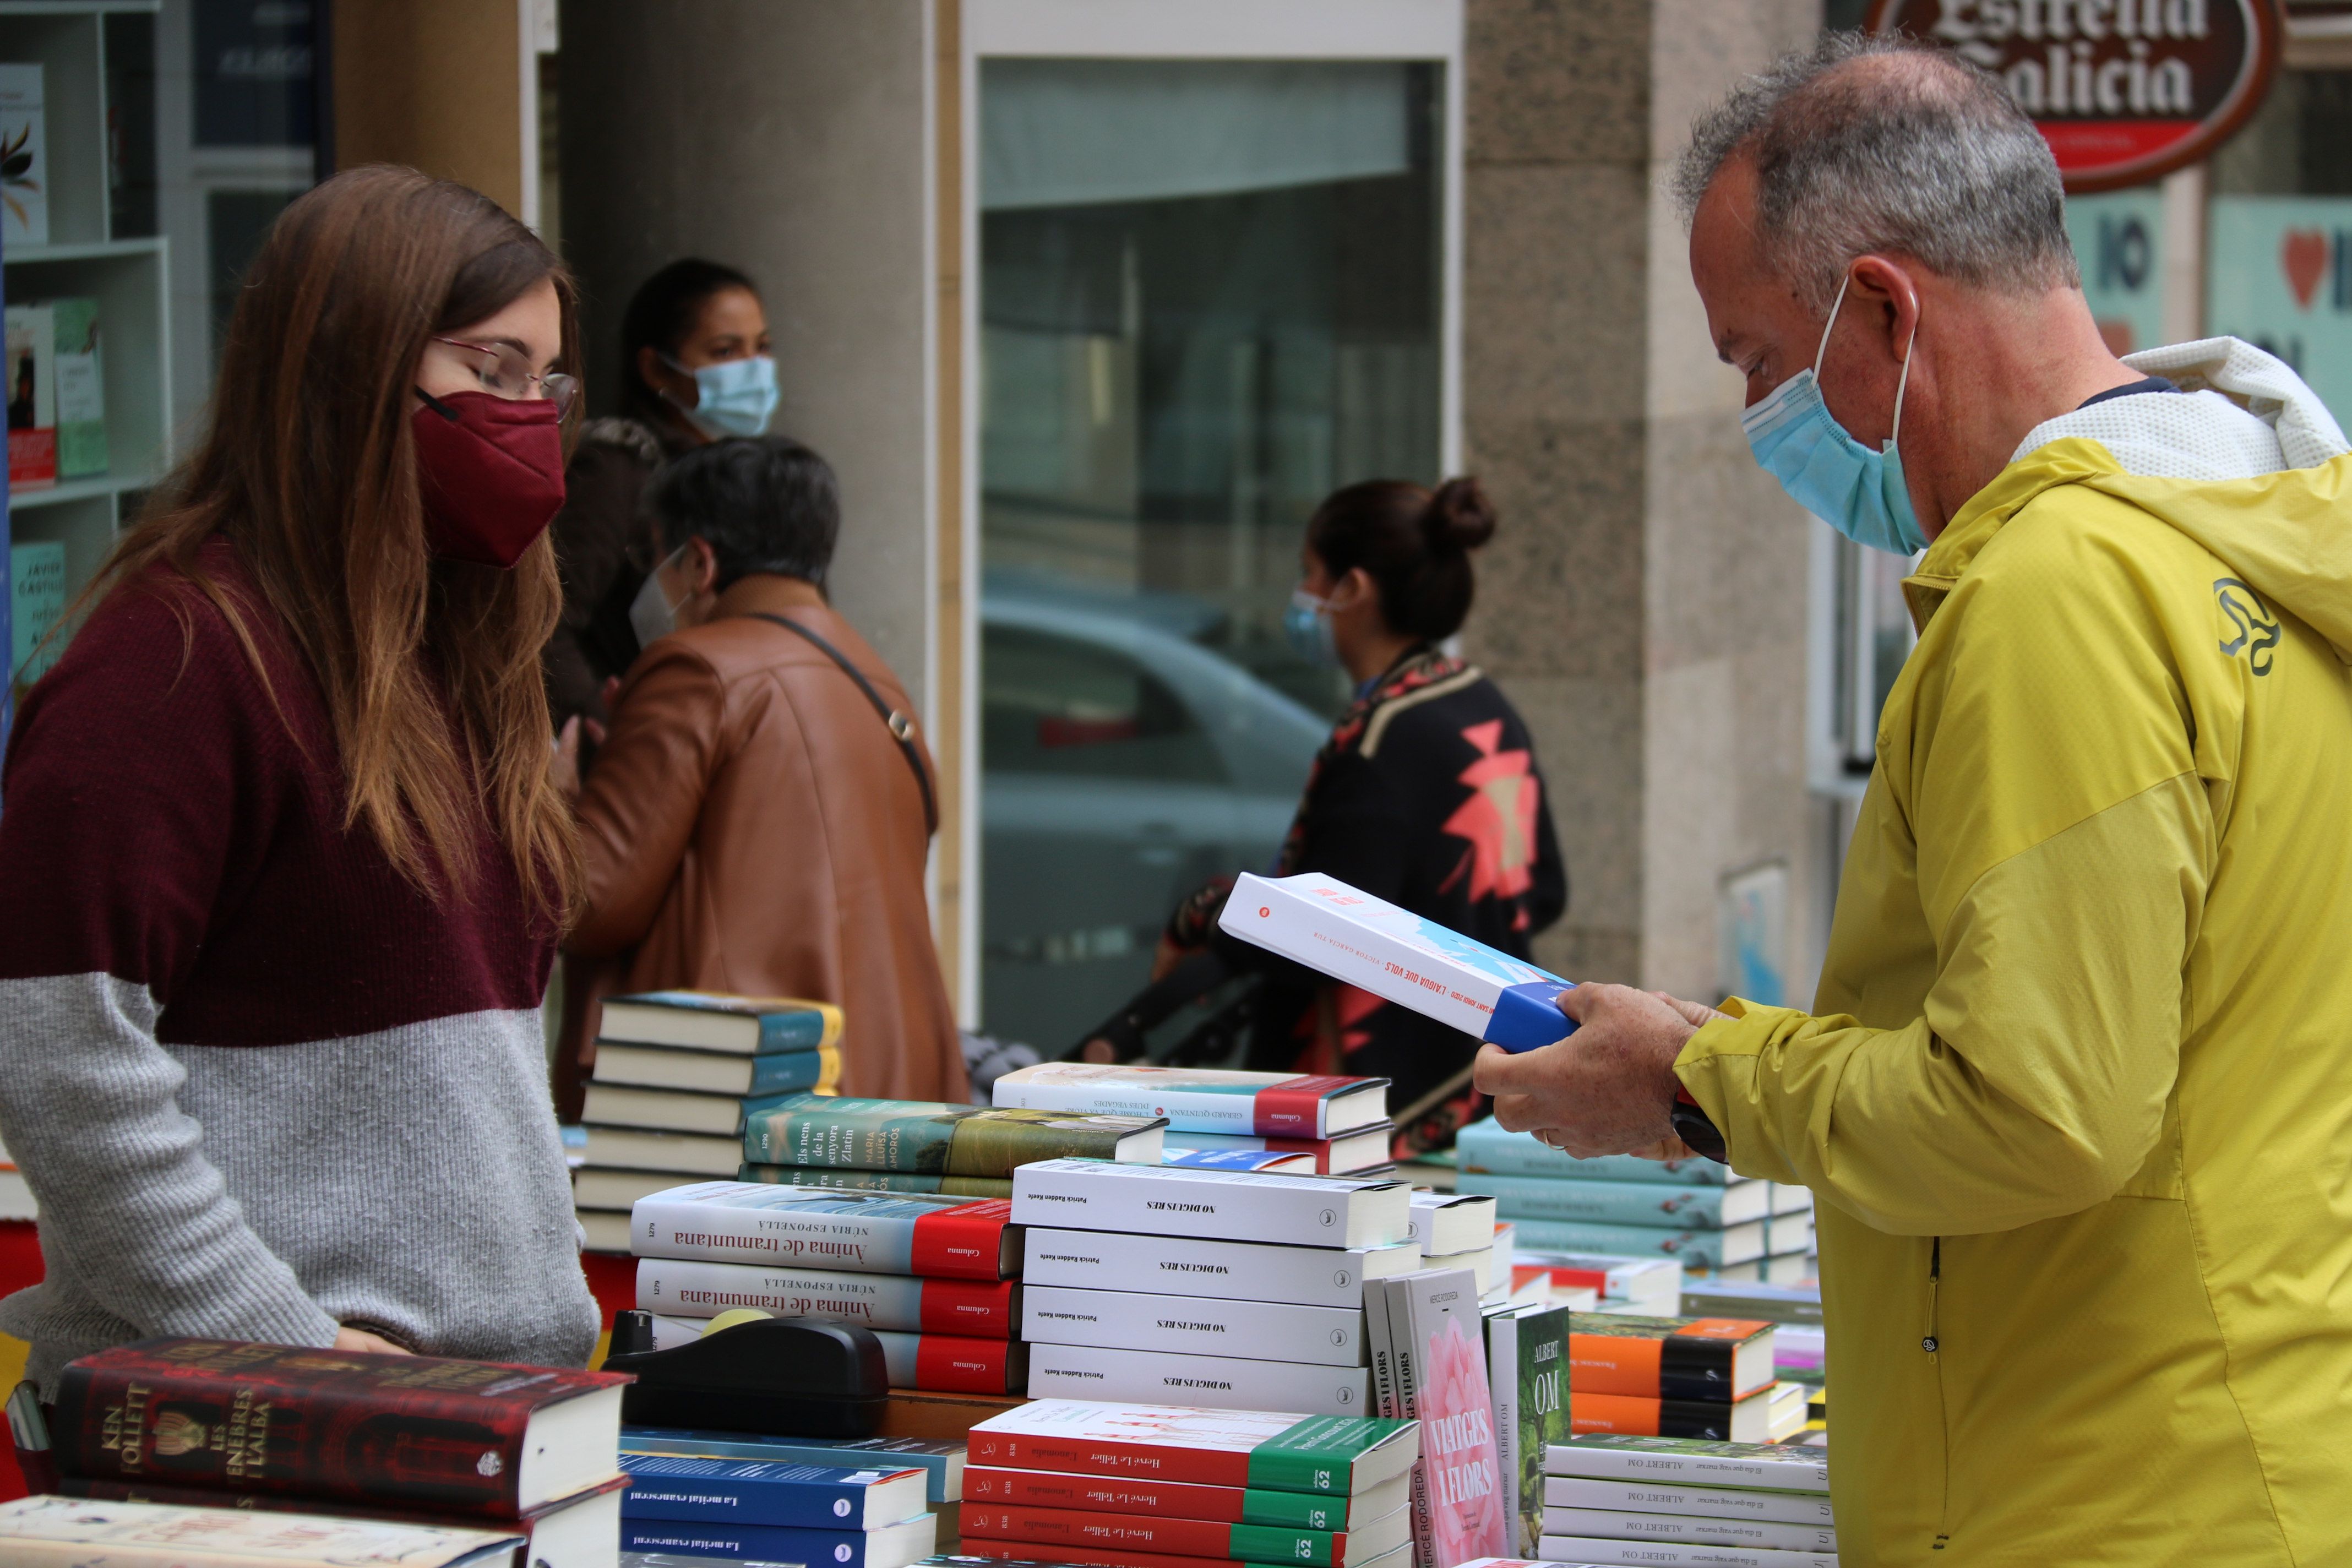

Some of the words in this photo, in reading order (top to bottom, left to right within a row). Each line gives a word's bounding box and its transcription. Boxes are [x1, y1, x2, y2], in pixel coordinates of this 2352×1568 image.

[1934, 0, 2209, 41] Estrella
[1314, 932, 1326, 942] TUR
[1385, 961, 1403, 977] VOLS
[1404, 970, 1419, 983] QUE
[1420, 976, 1446, 995] L'AIGUA
[1463, 995, 1476, 1006] JORDI
[1170, 1109, 1211, 1118] QUINTANA
[801, 1121, 811, 1144] nens
[813, 1131, 824, 1142] la
[812, 1144, 823, 1157] de
[827, 1125, 839, 1166] senyora
[841, 1129, 853, 1163] Zlatin
[865, 1131, 875, 1163] MARIA
[877, 1131, 888, 1165] LLUÏSA
[889, 1128, 900, 1170] AMORÓS
[798, 1145, 808, 1164] Els
[1147, 1201, 1165, 1210] RES
[1166, 1202, 1201, 1212] DIGUIS
[1202, 1205, 1216, 1213] NO
[831, 1225, 869, 1237] NÚRIA
[674, 1232, 778, 1251] tramuntana
[783, 1239, 804, 1256] de
[809, 1240, 868, 1265] Ànima
[947, 1247, 979, 1257] Columna
[1159, 1261, 1179, 1270] RES
[1180, 1263, 1215, 1273] DIGUIS
[1216, 1266, 1229, 1275] NO
[839, 1283, 876, 1295] NÚRIA
[680, 1289, 784, 1310] tramuntana
[1429, 1294, 1442, 1304] MERCÈ
[1441, 1291, 1458, 1303] RODOREDA
[790, 1295, 811, 1313] de
[816, 1297, 875, 1322] Ànima
[956, 1305, 989, 1315] Columna
[1156, 1320, 1175, 1329] RES
[1177, 1321, 1211, 1332] DIGUIS
[1212, 1324, 1226, 1333] NO
[1534, 1341, 1559, 1363] ALBERT
[952, 1361, 986, 1371] Columna
[1376, 1351, 1389, 1389] FLORS
[1400, 1352, 1412, 1390] FLORS
[1163, 1377, 1182, 1386] RES
[1183, 1379, 1218, 1390] DIGUIS
[1218, 1381, 1233, 1391] NO
[1534, 1369, 1560, 1415] OM
[1382, 1396, 1392, 1418] GES
[1405, 1397, 1415, 1419] GES
[1501, 1403, 1507, 1419] OM
[101, 1405, 124, 1450] KEN
[119, 1380, 153, 1474] FOLLETT
[1430, 1407, 1490, 1456] VIATGES
[210, 1423, 227, 1451] LES
[246, 1401, 273, 1467] L'ALBA
[1091, 1453, 1118, 1465] Tellier
[1120, 1456, 1131, 1466] Le
[1134, 1458, 1160, 1468] Hervé
[1627, 1458, 1643, 1467] OM
[1646, 1460, 1684, 1470] ALBERT
[1719, 1463, 1732, 1472] vaig
[1319, 1471, 1330, 1489] 62
[1438, 1470, 1449, 1507] I
[1447, 1458, 1493, 1505] FLORS
[630, 1491, 687, 1501] evanescent
[688, 1495, 722, 1505] meitat
[723, 1496, 738, 1507] La
[1086, 1490, 1114, 1502] Tellier
[1117, 1494, 1128, 1504] Le
[1130, 1495, 1157, 1506] Hervé
[1414, 1468, 1430, 1532] RODOREDA
[1628, 1492, 1643, 1501] OM
[1646, 1494, 1684, 1504] ALBERT
[1720, 1497, 1733, 1505] vaig
[1314, 1510, 1326, 1529] 62
[1083, 1525, 1110, 1537] Tellier
[1626, 1522, 1642, 1531] OM
[1644, 1523, 1683, 1533] ALBERT
[1719, 1527, 1732, 1535] vaig
[1113, 1528, 1124, 1538] Le
[1127, 1530, 1153, 1540] Hervé
[633, 1537, 689, 1547] evanescent
[690, 1539, 724, 1550] meitat
[726, 1541, 740, 1551] La
[1300, 1539, 1311, 1559] 62
[1622, 1550, 1637, 1559] OM
[1640, 1551, 1678, 1562] ALBERT
[1714, 1555, 1728, 1563] vaig
